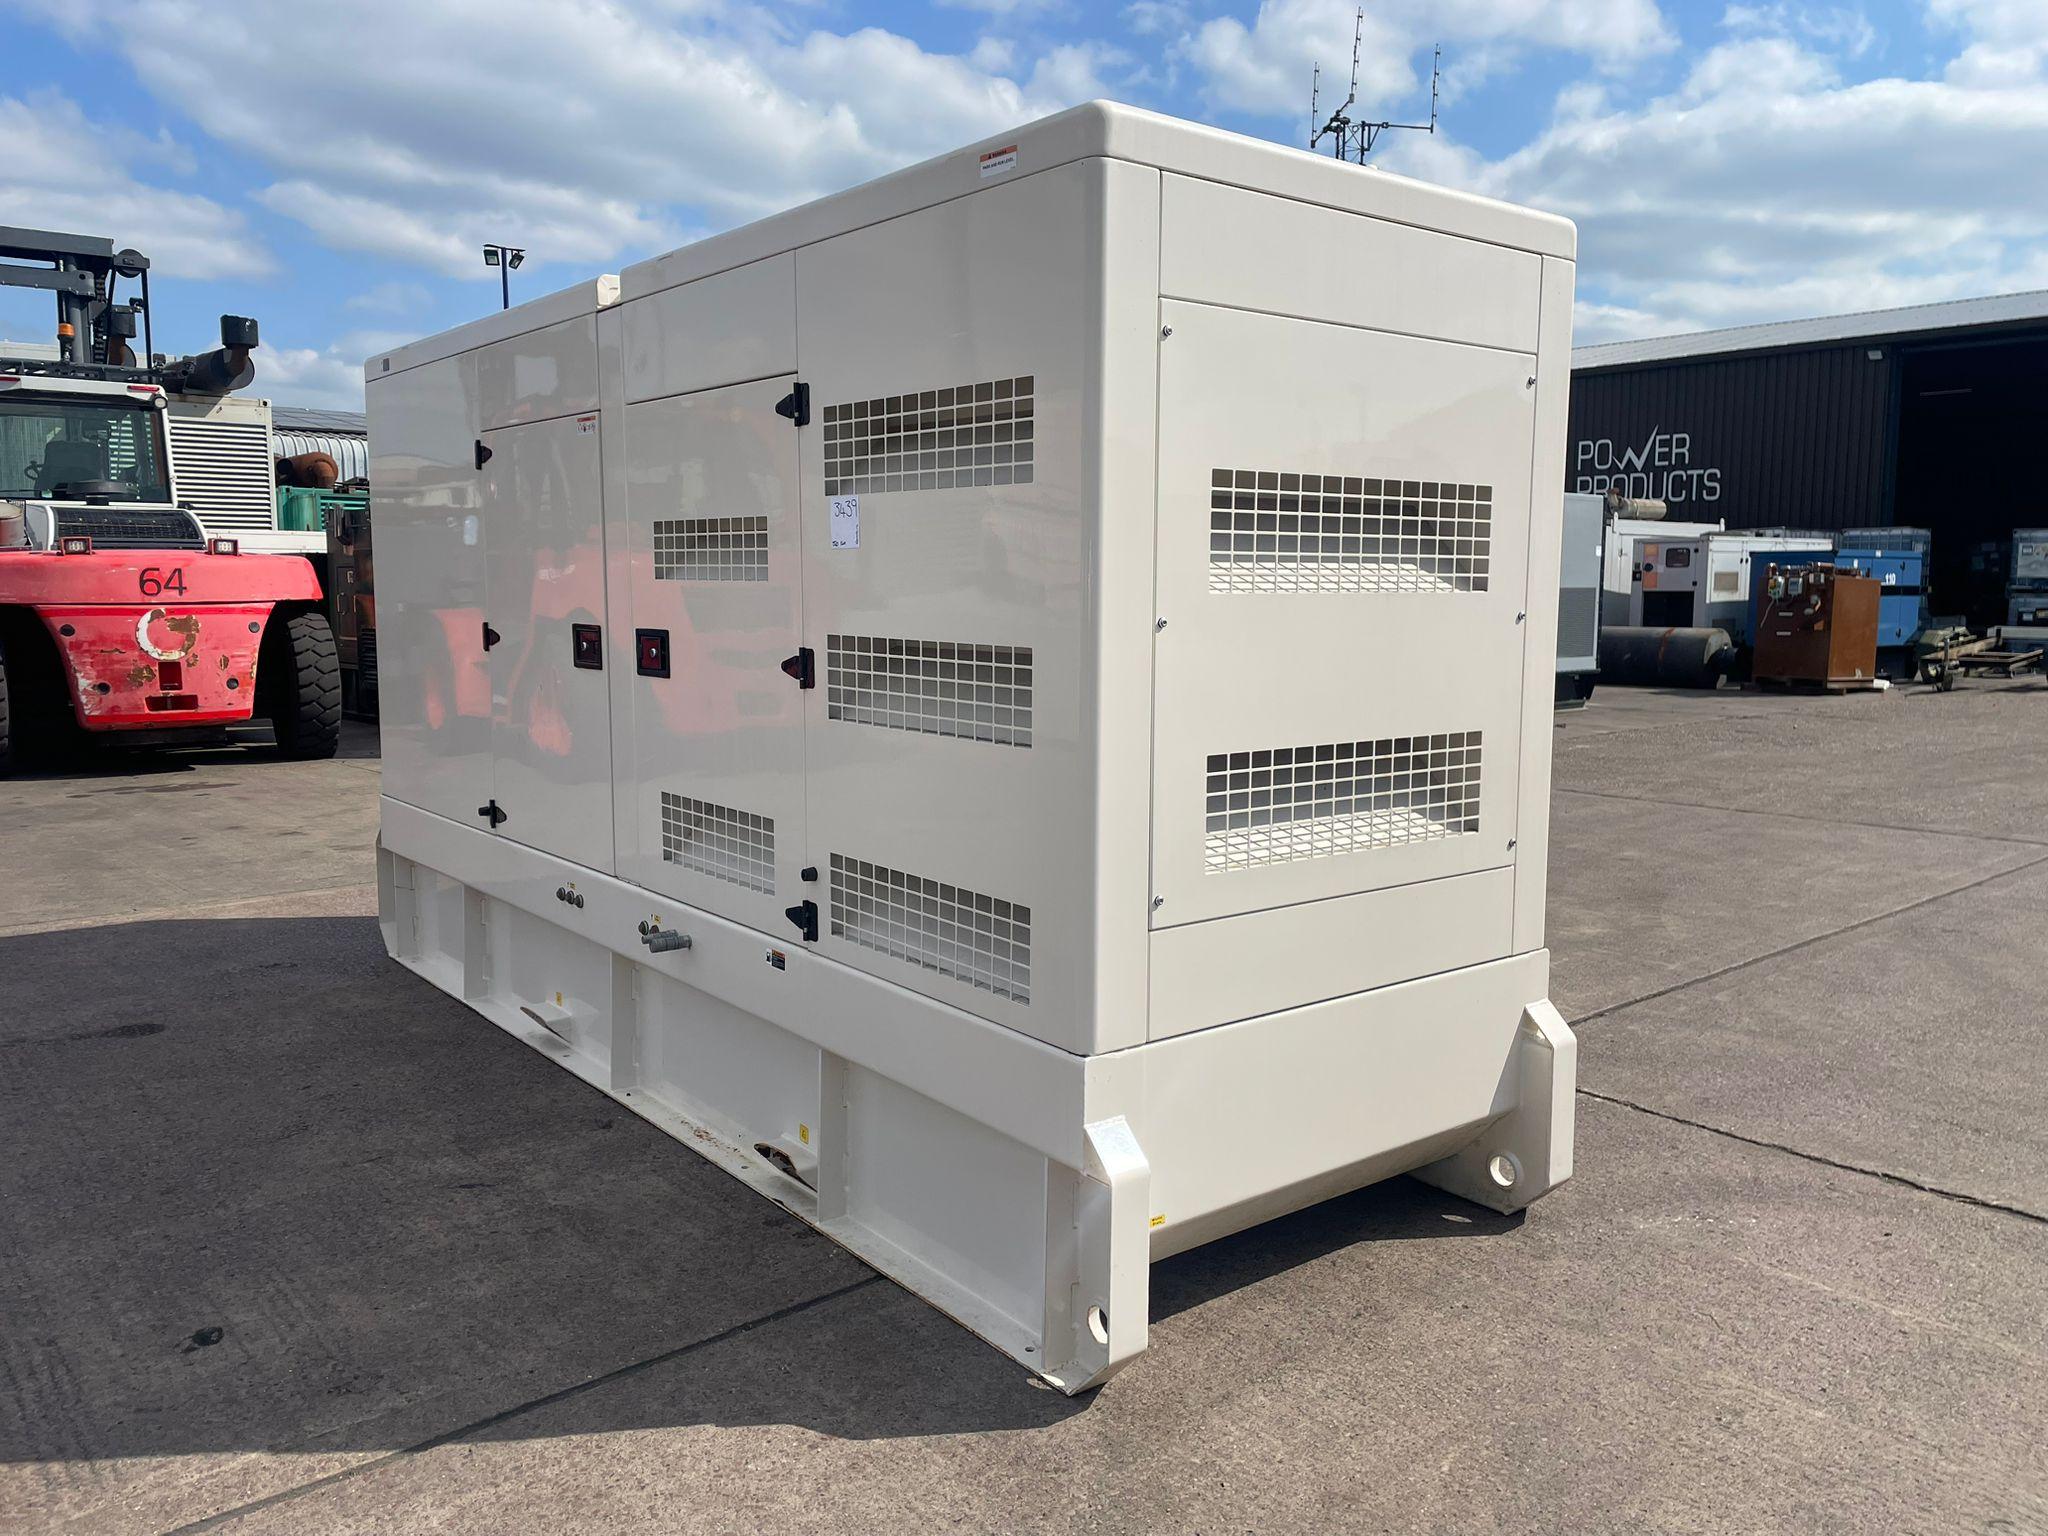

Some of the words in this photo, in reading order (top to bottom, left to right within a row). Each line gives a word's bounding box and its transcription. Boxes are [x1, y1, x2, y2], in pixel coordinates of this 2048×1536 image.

[1577, 424, 1691, 472] POWER
[1576, 468, 1721, 502] PRODUCTS
[833, 498, 858, 519] 3439
[139, 567, 187, 597] 64
